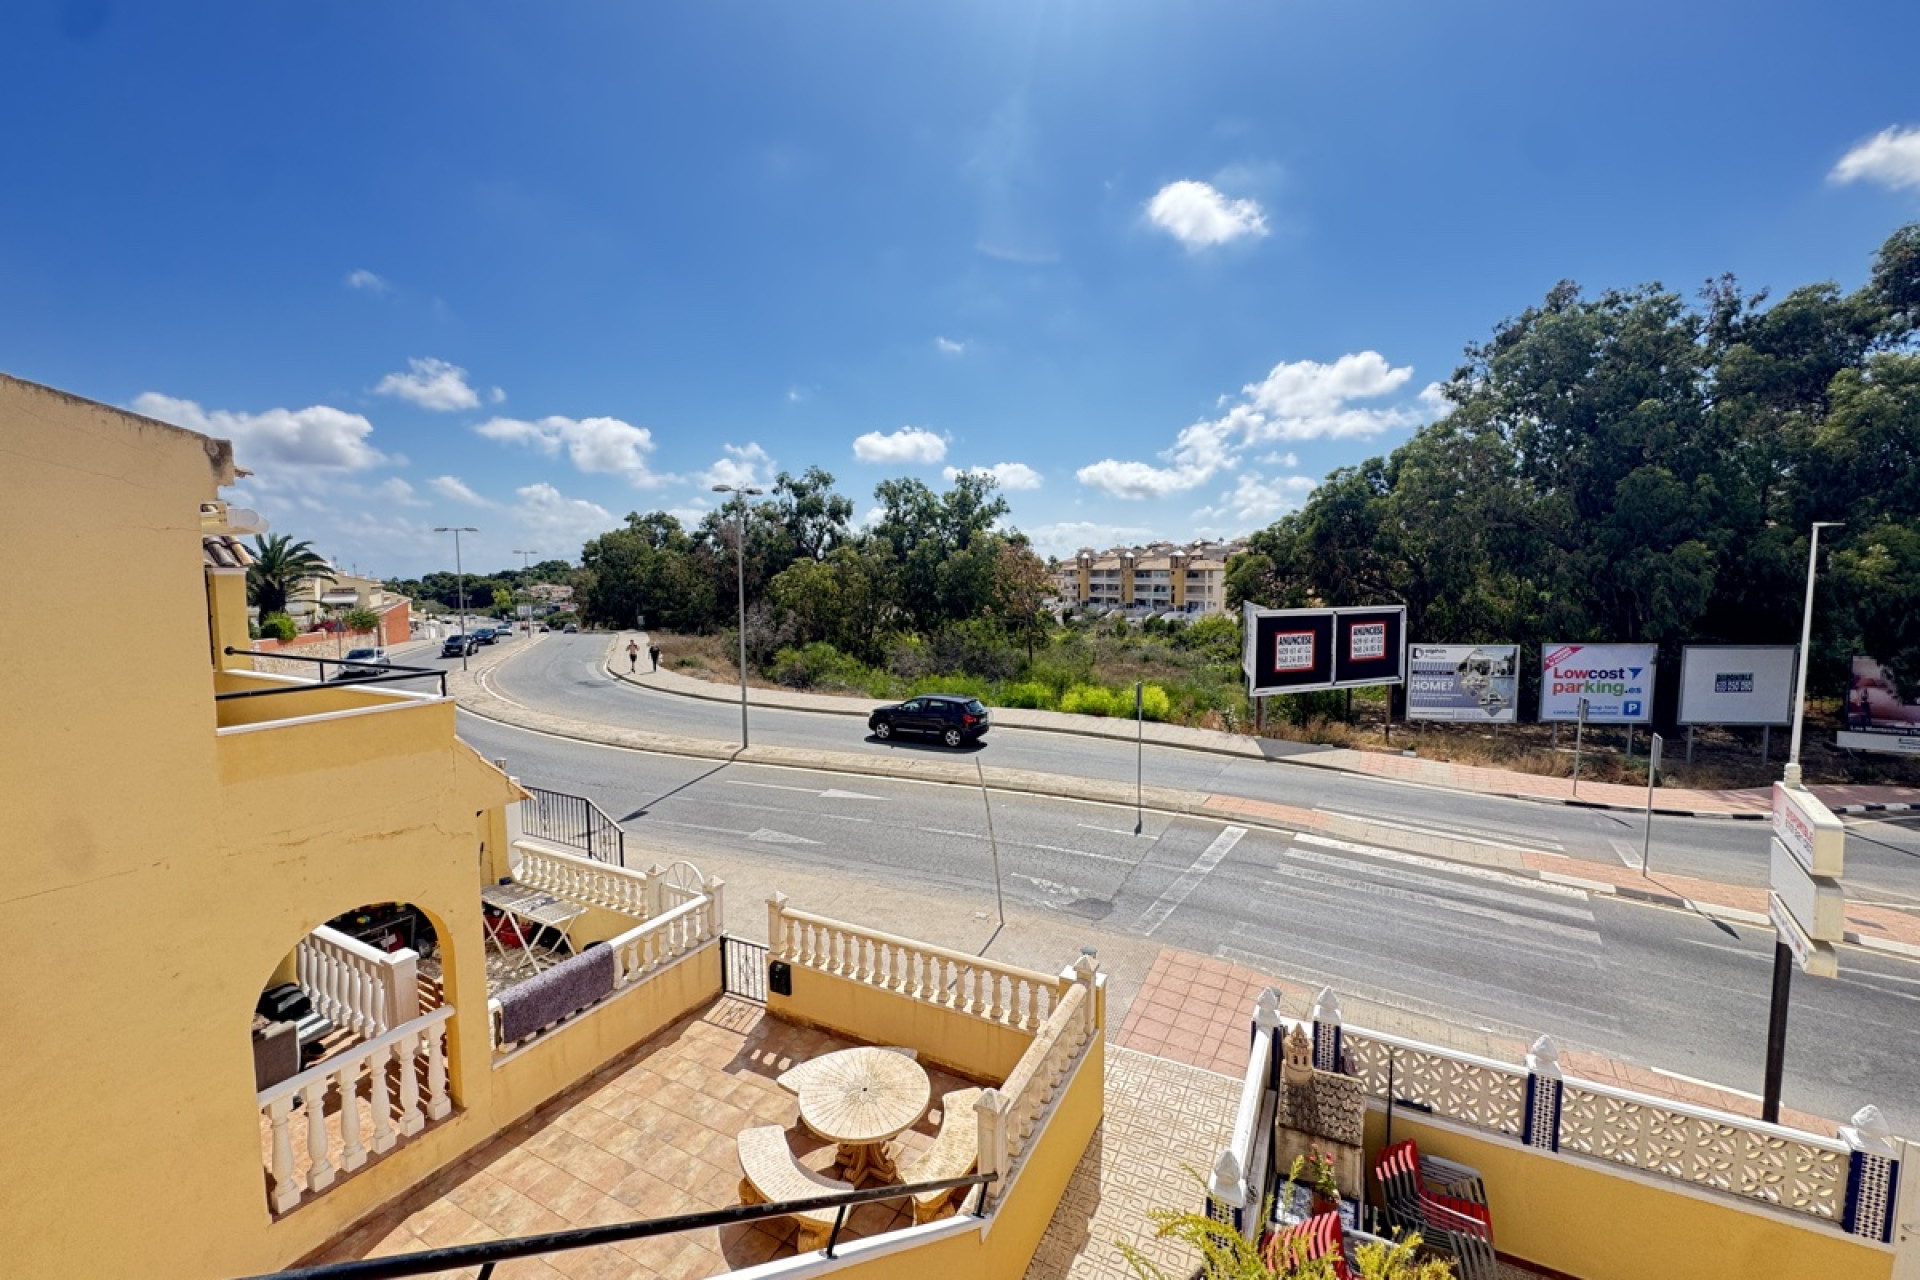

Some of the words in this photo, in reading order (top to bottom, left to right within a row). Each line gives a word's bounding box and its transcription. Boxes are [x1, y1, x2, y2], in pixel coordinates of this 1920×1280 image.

[1553, 667, 1625, 679] Lowcost
[1411, 681, 1454, 691] HOME?
[1552, 680, 1642, 696] parking.es
